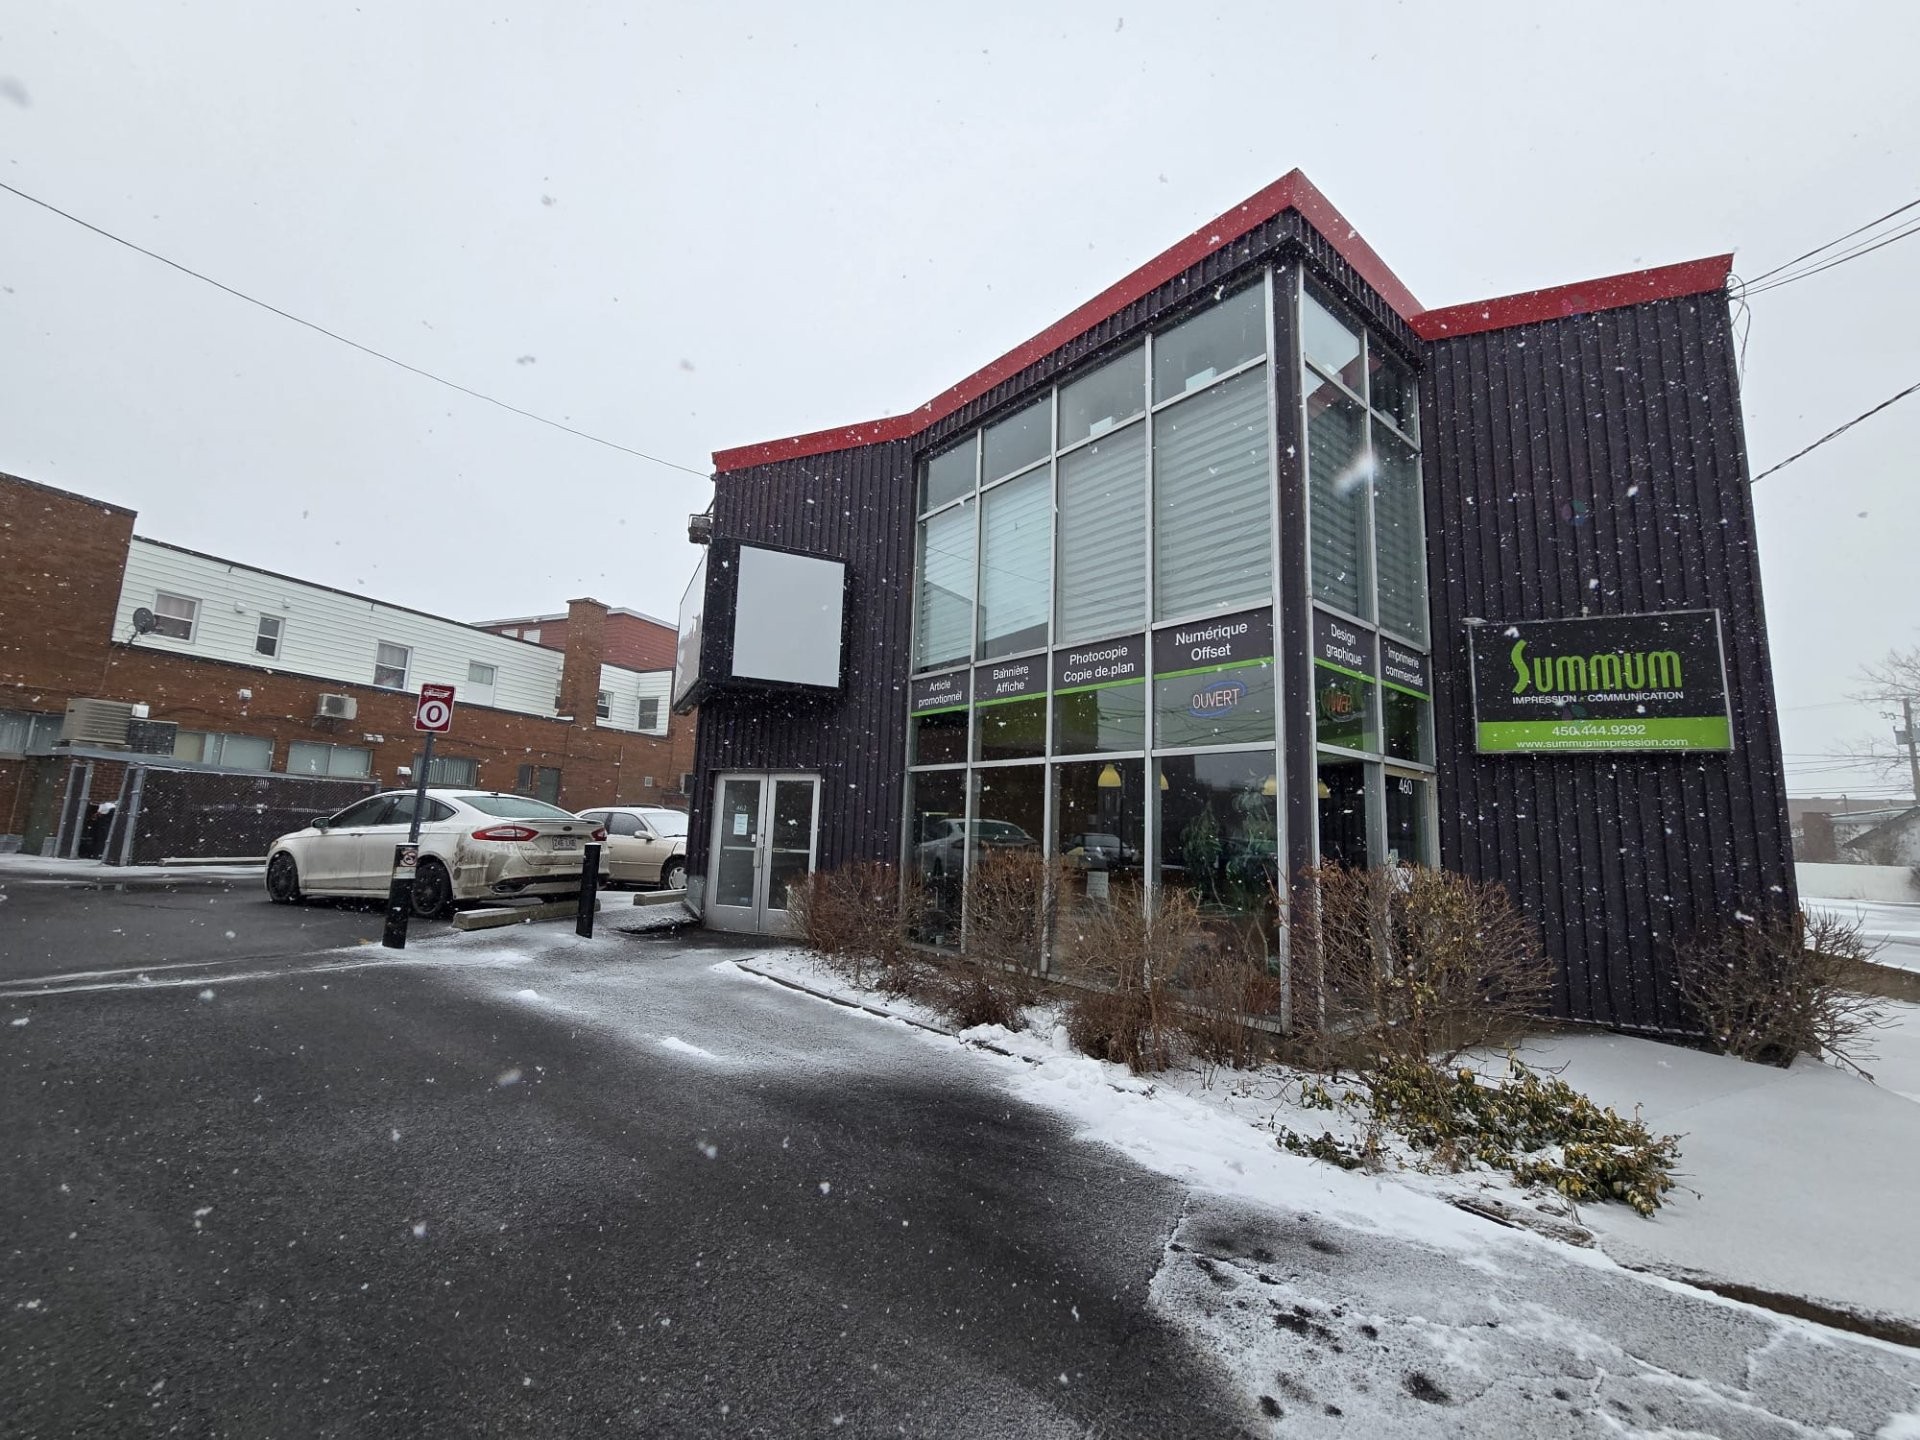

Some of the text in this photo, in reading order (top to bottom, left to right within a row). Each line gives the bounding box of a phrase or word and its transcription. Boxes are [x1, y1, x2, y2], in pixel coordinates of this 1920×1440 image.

[1175, 623, 1248, 646] Numérique
[1330, 623, 1357, 646] Design
[1069, 645, 1128, 666] Photocopie
[1191, 643, 1232, 661] Offset
[1326, 643, 1363, 667] graphique
[1387, 646, 1420, 669] Imprimerie
[993, 665, 1029, 680] Bannière
[1063, 662, 1135, 683] Copie de plan
[1385, 665, 1423, 687] commerciale
[929, 680, 951, 692] Article
[996, 680, 1025, 694] Affiche
[918, 691, 962, 709] promotionnel
[1192, 688, 1240, 709] OUVERT
[1512, 691, 1684, 705] IMPRESSION COMMUNICATION
[1551, 724, 1646, 736] 450.444.9292
[1516, 738, 1688, 748] www.summumimpression.com
